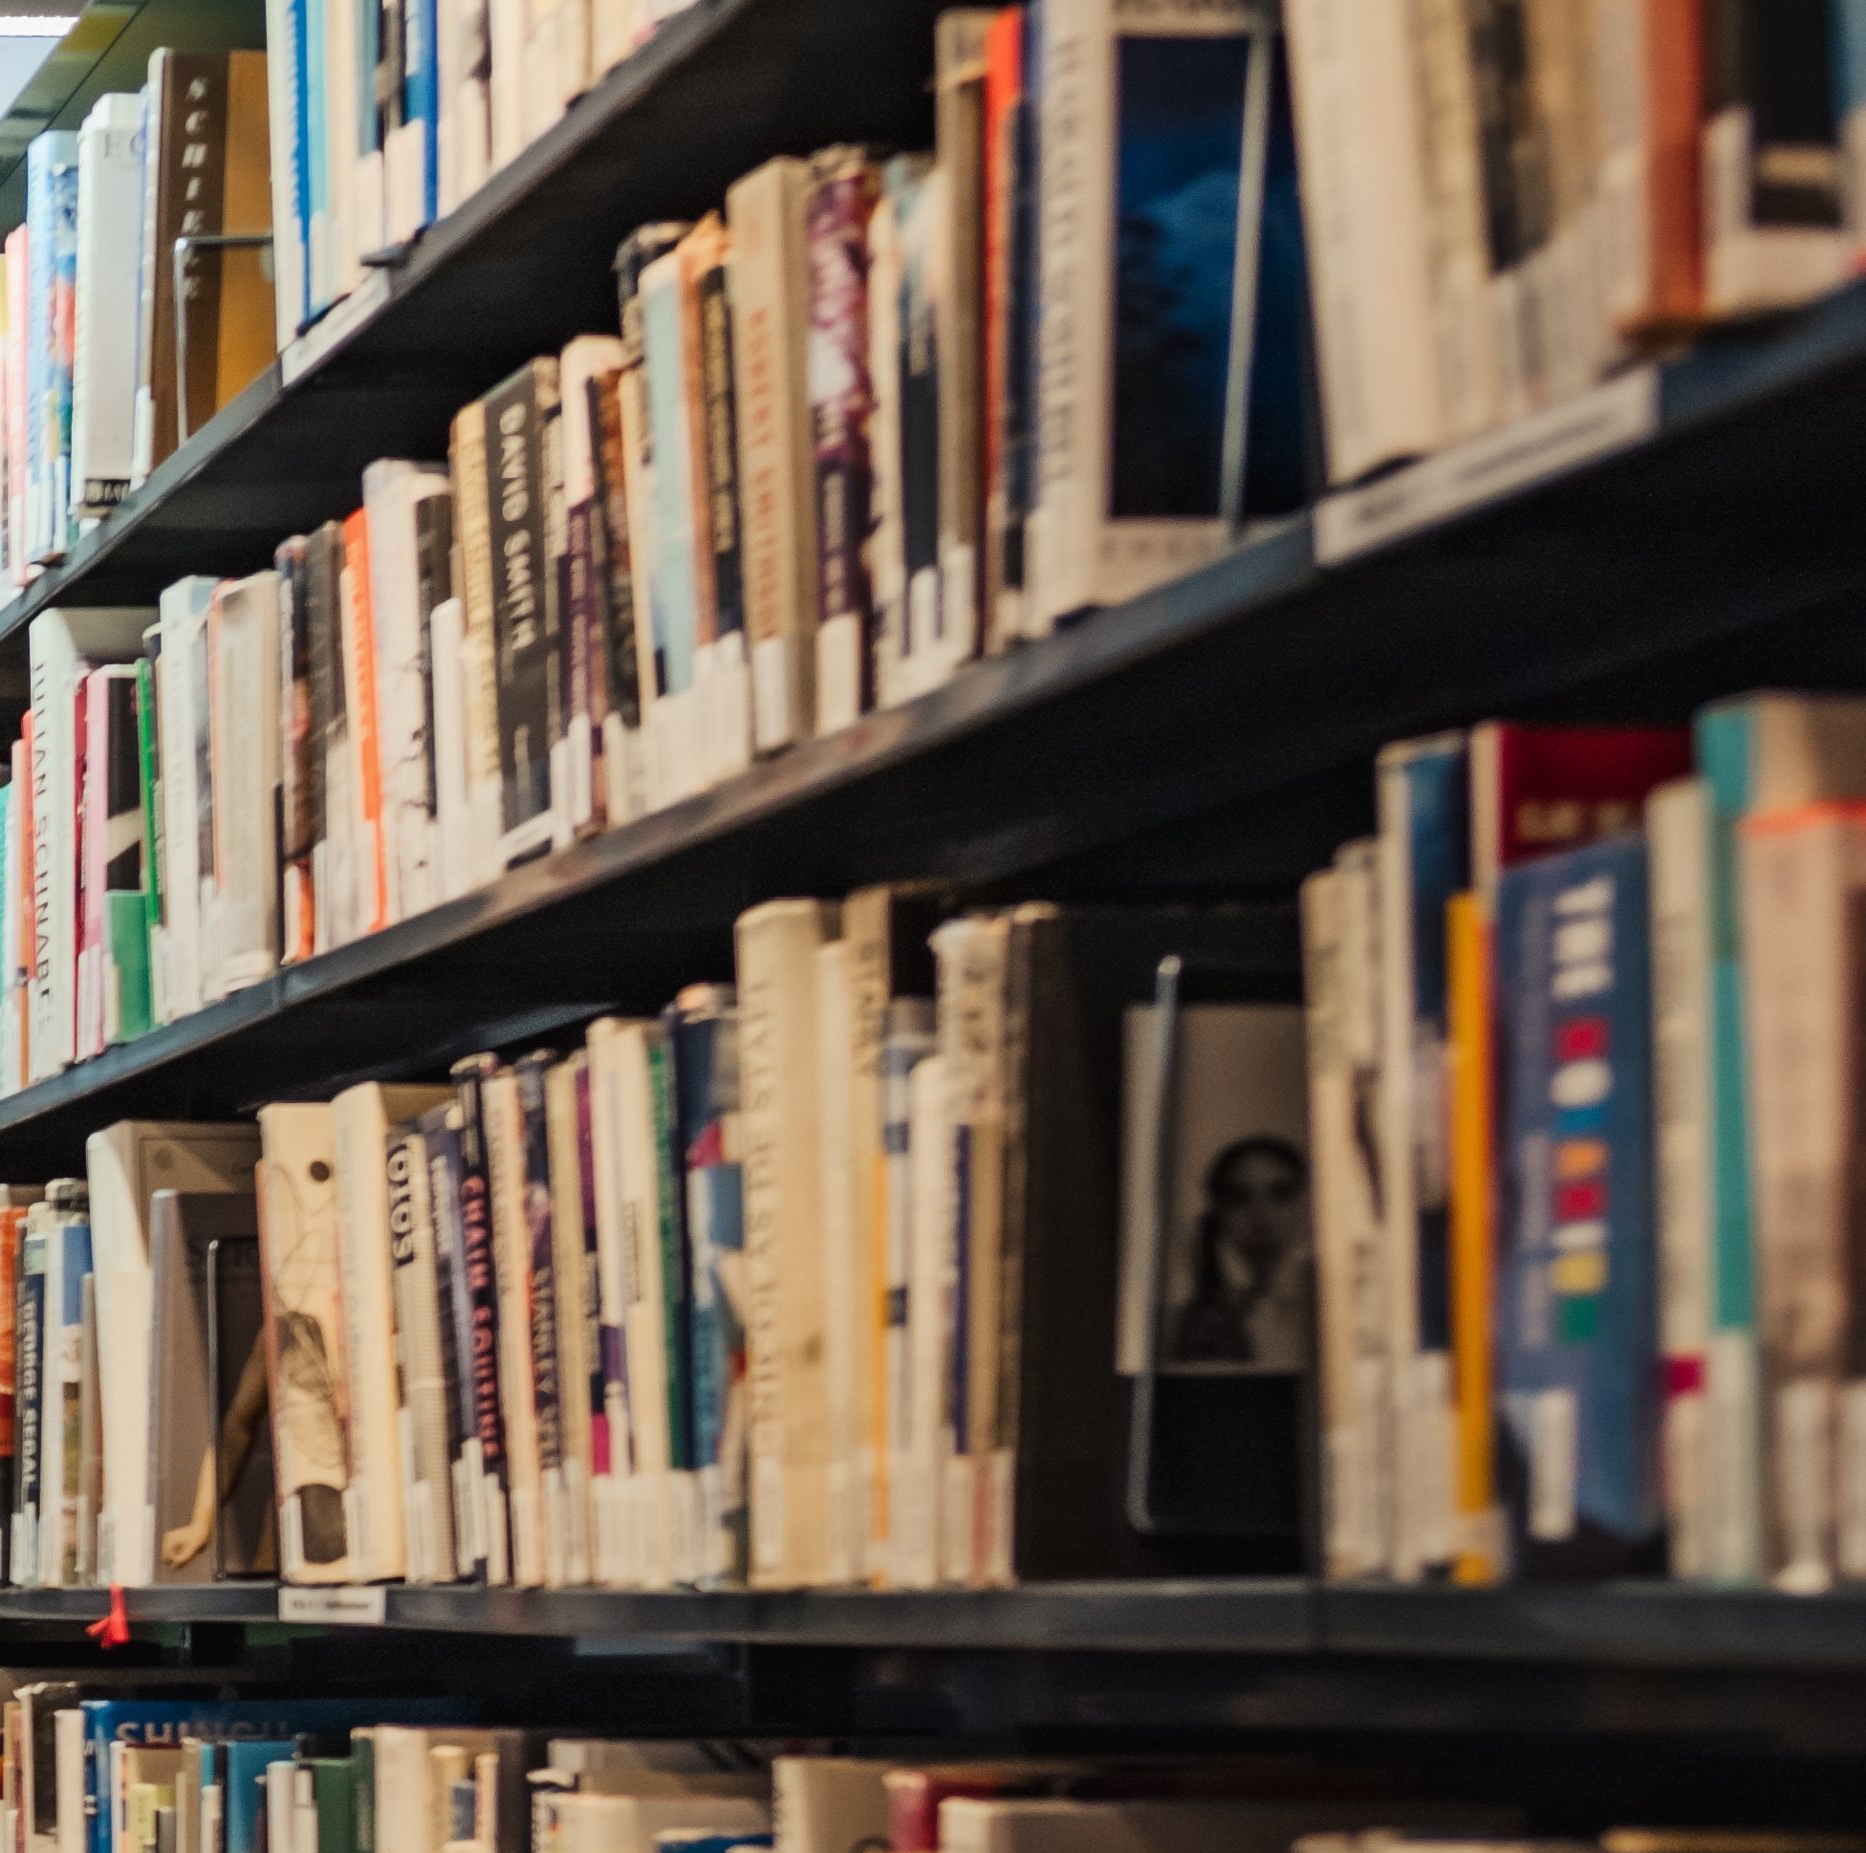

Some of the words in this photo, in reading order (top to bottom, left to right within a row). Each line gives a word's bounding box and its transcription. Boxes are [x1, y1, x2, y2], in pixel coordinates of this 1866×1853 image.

[499, 402, 530, 522] DAVID
[503, 528, 537, 652] SMITH
[31, 660, 48, 800] JULIAN
[33, 815, 54, 1041] SCHNABEL
